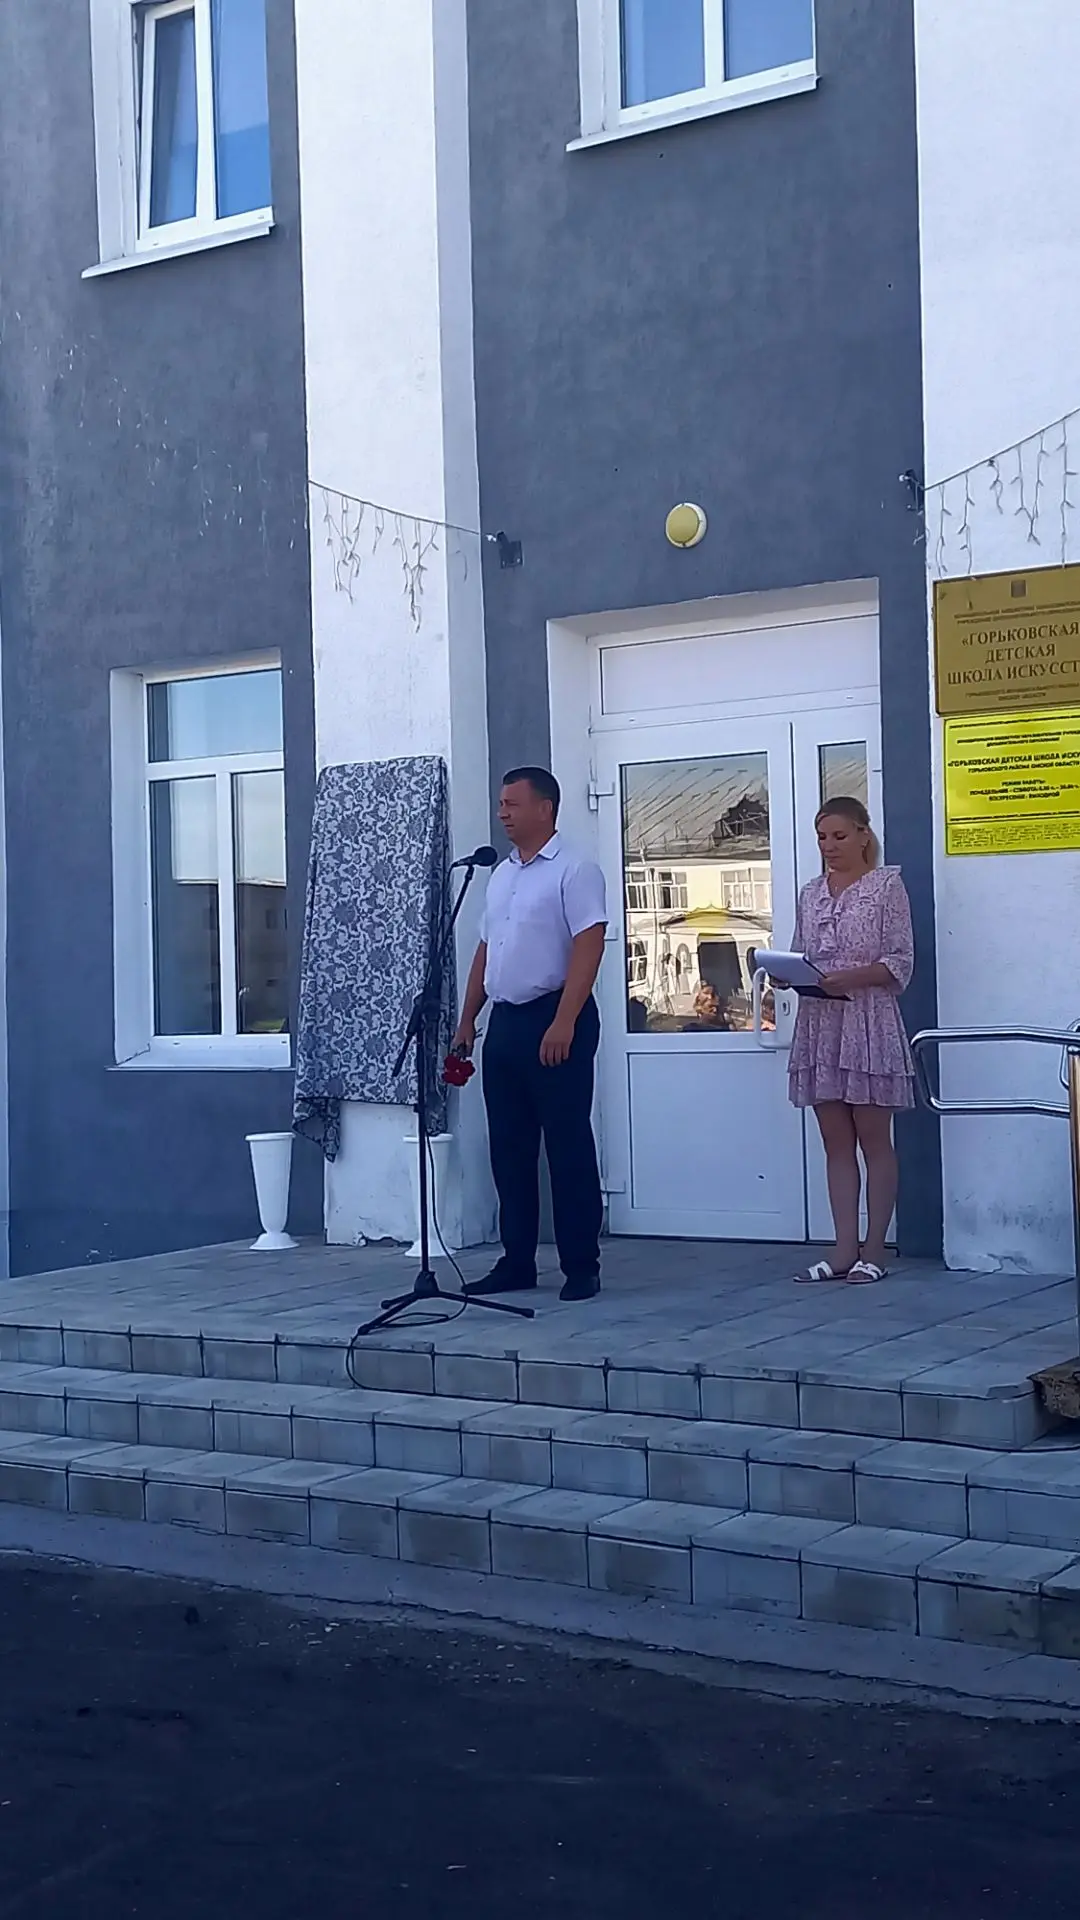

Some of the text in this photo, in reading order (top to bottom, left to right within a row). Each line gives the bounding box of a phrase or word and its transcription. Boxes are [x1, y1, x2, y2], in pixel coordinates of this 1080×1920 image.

[962, 621, 1079, 646] «ГОРЬКОВСКАЯ
[985, 643, 1056, 664] ДЕТСКАЯ
[947, 660, 1080, 685] ШКОЛА ИСКУССТ
